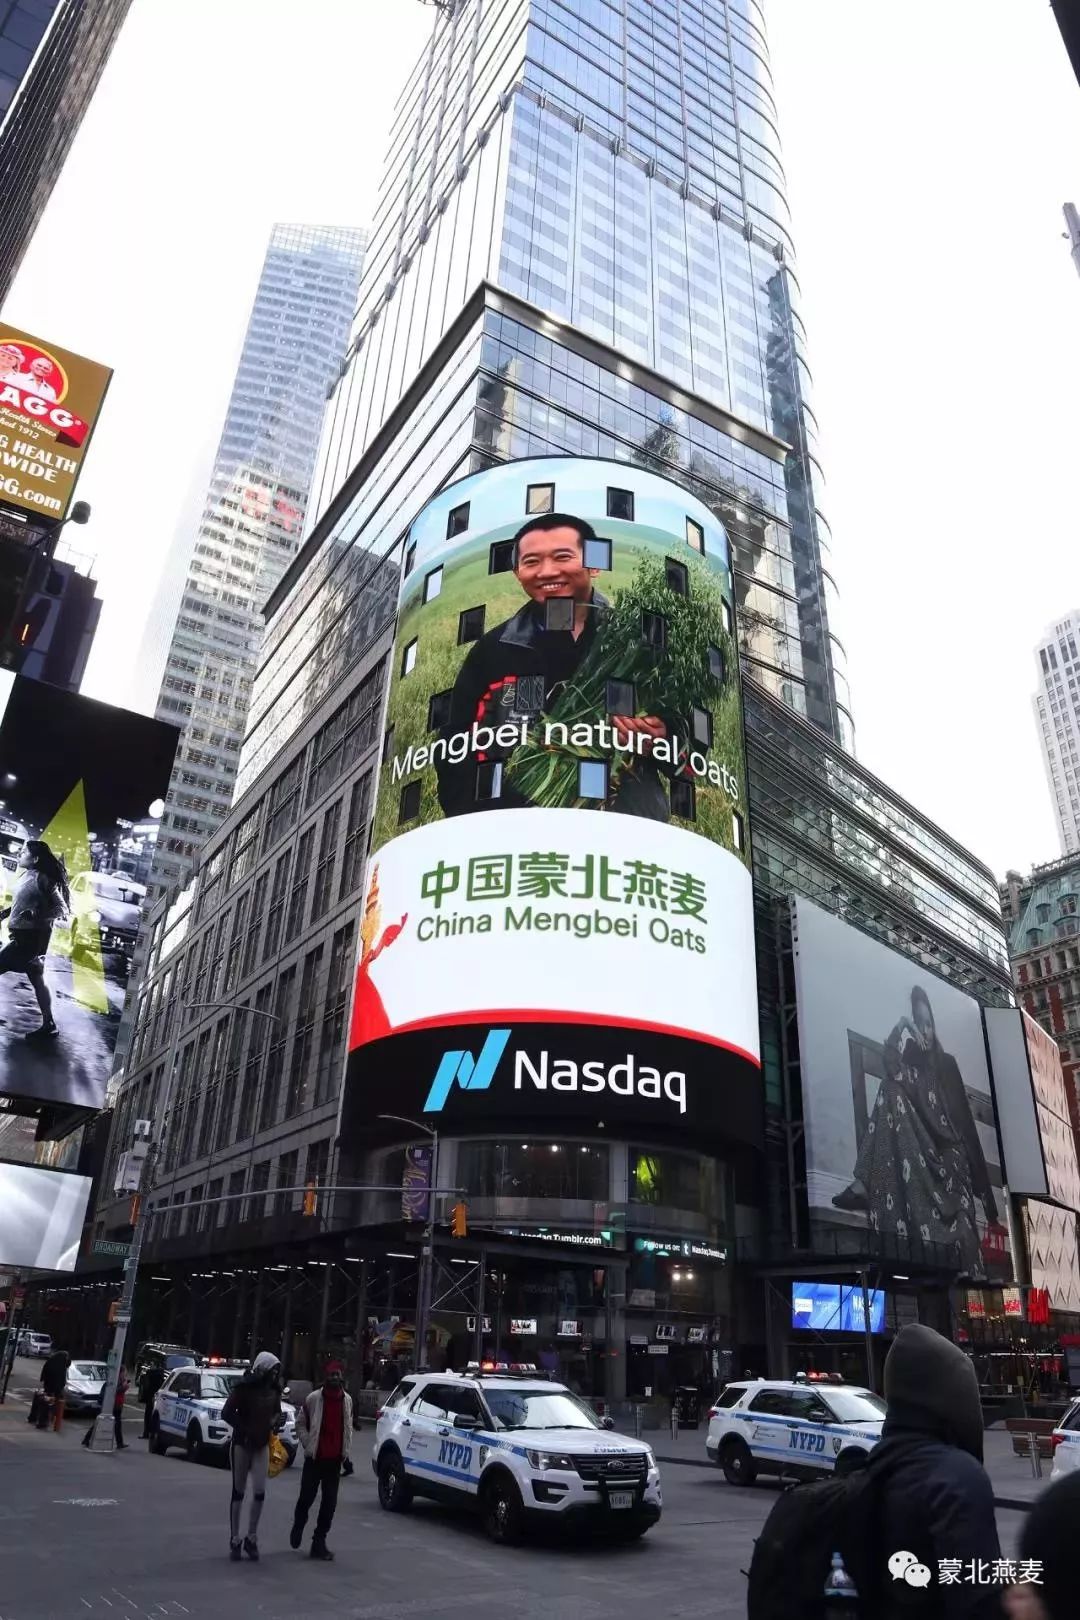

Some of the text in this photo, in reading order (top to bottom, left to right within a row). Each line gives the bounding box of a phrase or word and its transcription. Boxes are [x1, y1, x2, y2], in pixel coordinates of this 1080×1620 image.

[18, 423, 40, 440] 1912
[0, 450, 58, 483] WIDE
[13, 439, 77, 474] HEALTH
[391, 715, 740, 798] Mengbei natural oats
[420, 851, 708, 924] 中国蒙北燕麦
[416, 906, 707, 954] China Mengbei Oats
[514, 1050, 687, 1114] Nasdaq
[95, 1241, 127, 1255] BROADWAY
[437, 1439, 473, 1469] NYPD
[788, 1430, 826, 1452] NYPD
